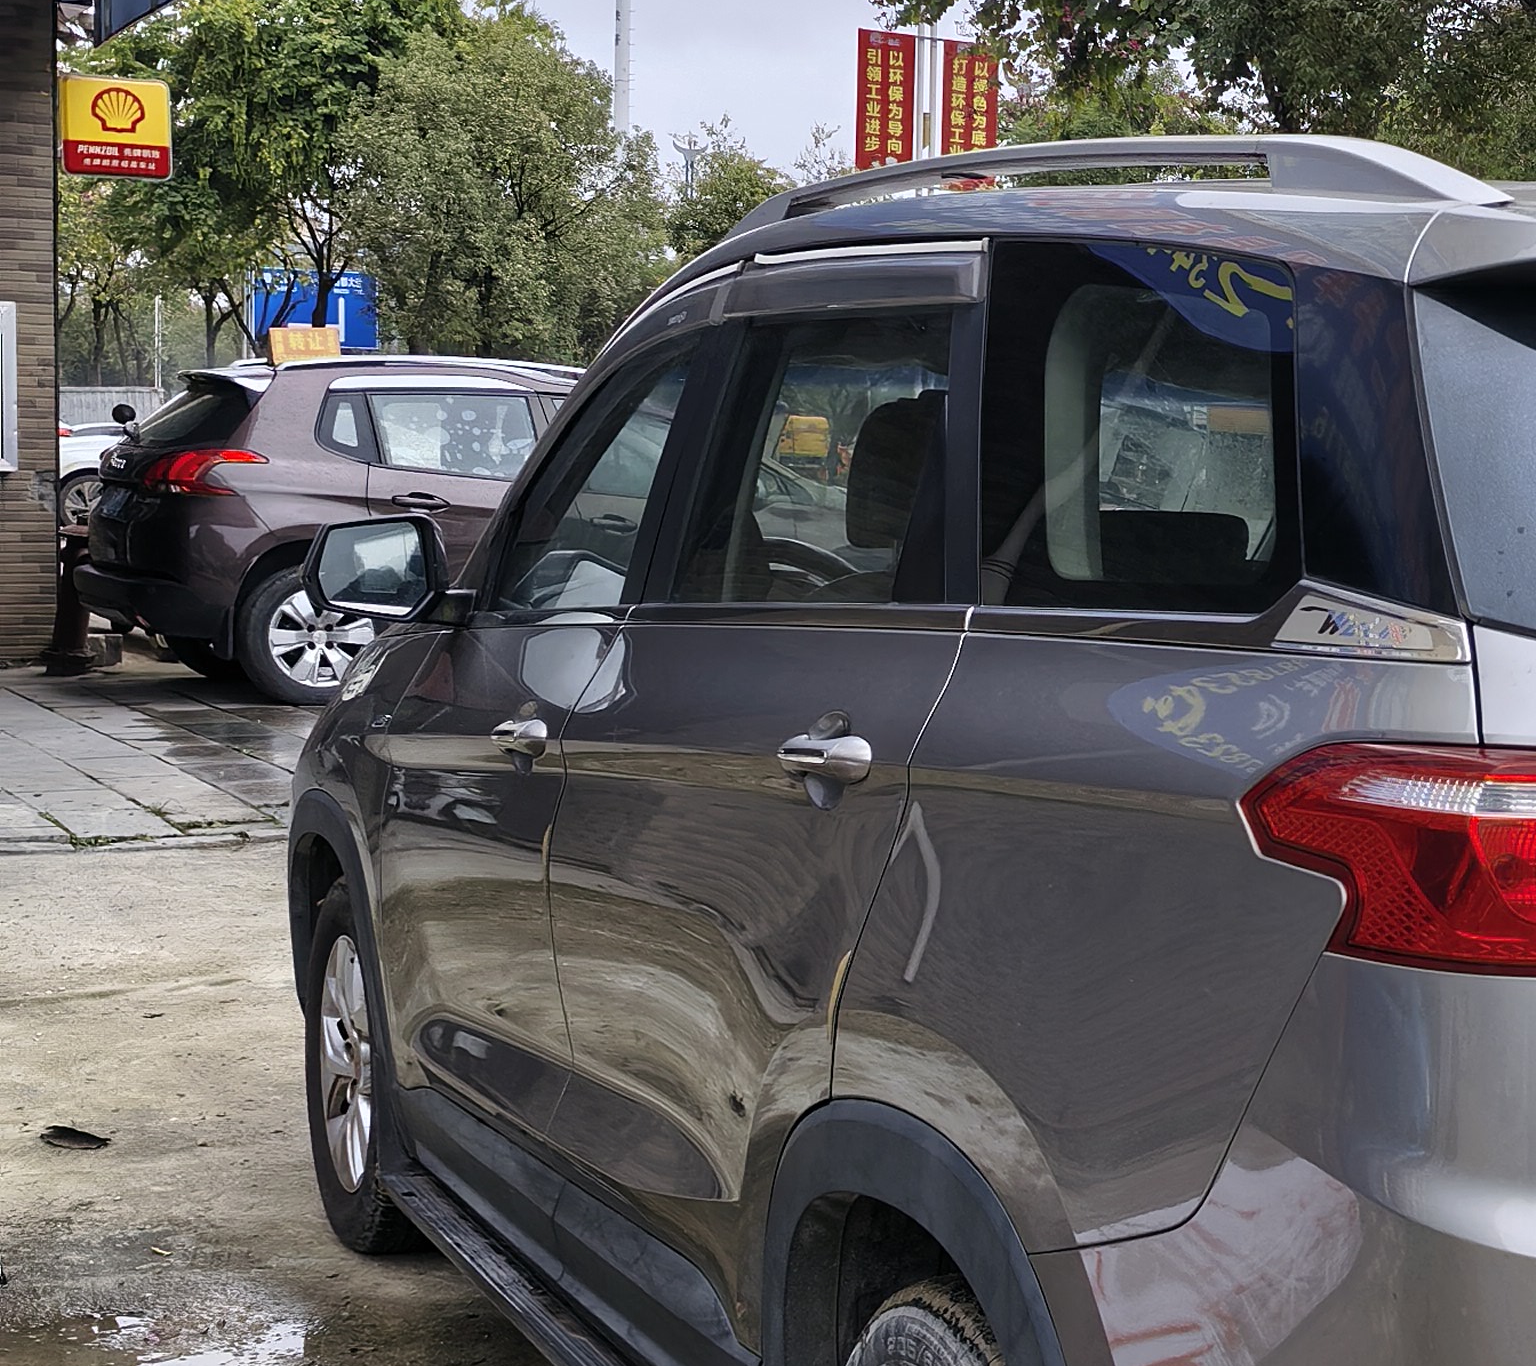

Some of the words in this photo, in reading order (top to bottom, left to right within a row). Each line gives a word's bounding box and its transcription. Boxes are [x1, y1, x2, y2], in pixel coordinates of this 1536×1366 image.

[864, 48, 882, 152] 引领工业进步
[887, 50, 904, 154] 以环保为导向
[970, 61, 989, 153] 以绿色为底
